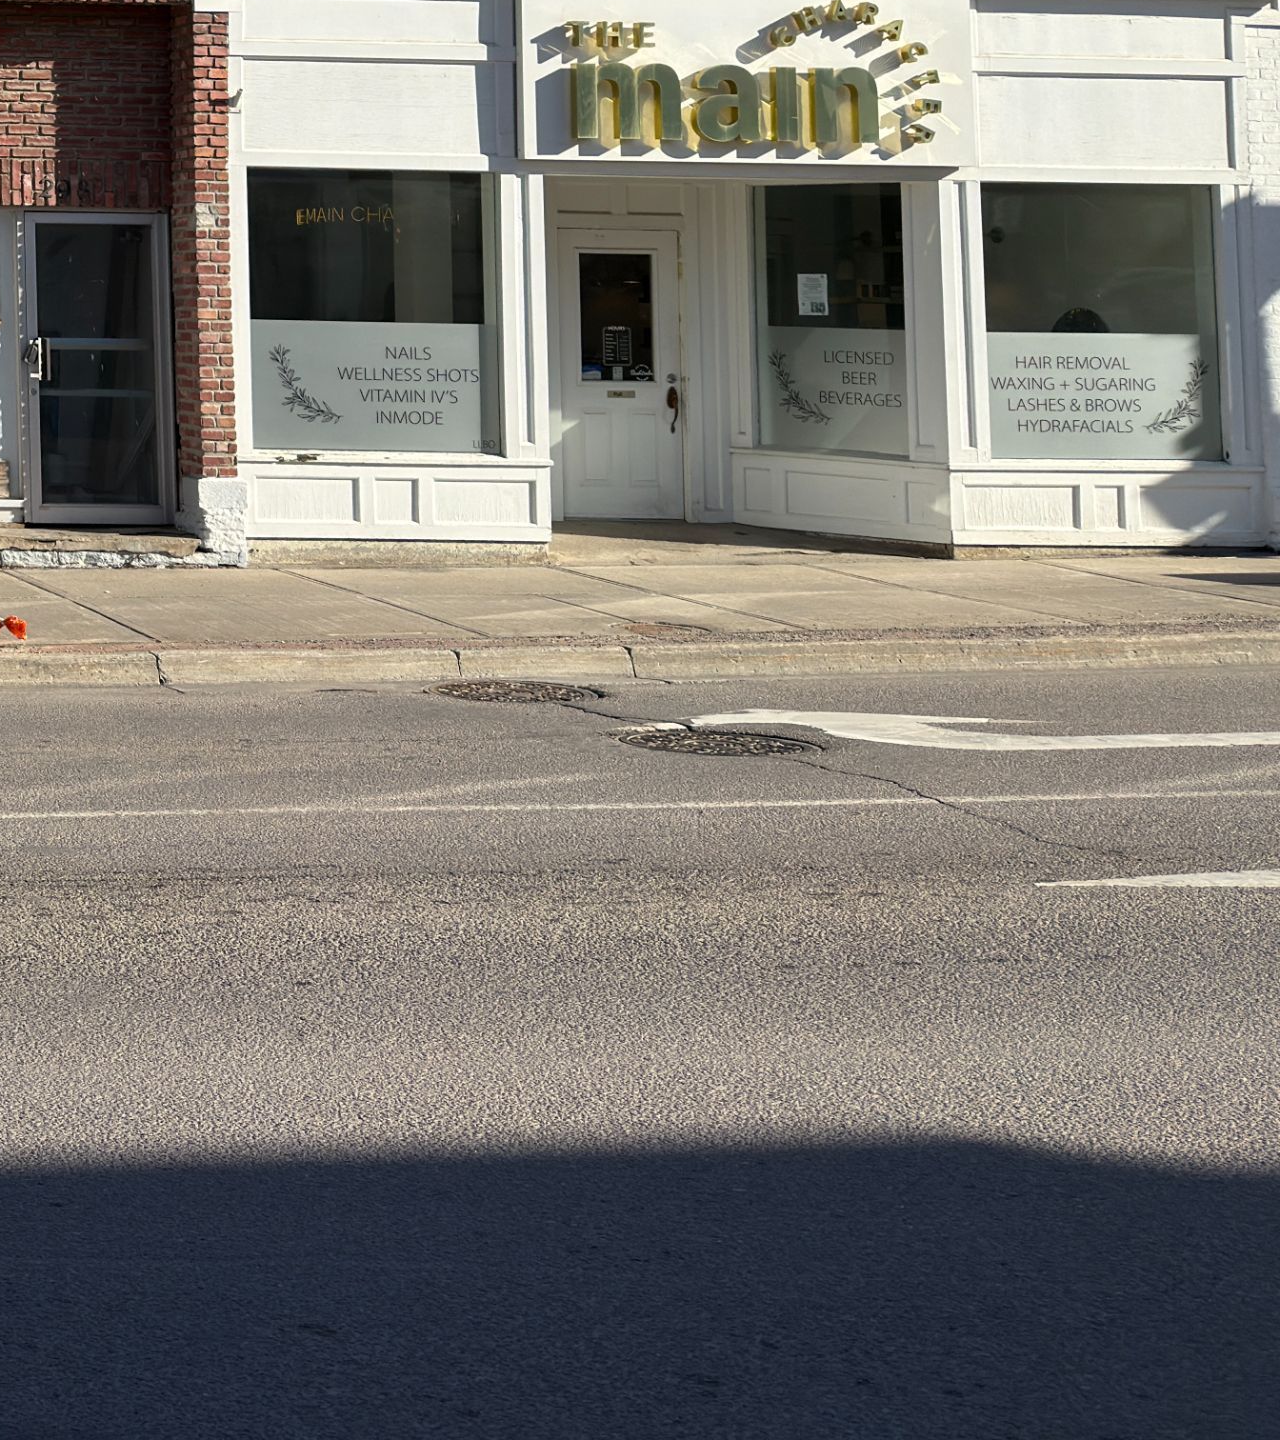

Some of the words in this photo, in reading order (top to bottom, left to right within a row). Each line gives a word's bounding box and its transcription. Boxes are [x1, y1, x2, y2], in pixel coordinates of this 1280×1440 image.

[567, 20, 656, 48] THE
[570, 62, 880, 145] main
[306, 207, 344, 224] MAIN
[385, 346, 432, 360] NAILS
[823, 350, 895, 365] LICENSED
[1015, 355, 1052, 369] HAIR
[1056, 356, 1131, 370] REMOVAL
[337, 367, 422, 381] WELLNESS
[427, 368, 480, 383] SHOTS
[842, 371, 877, 385] BEER
[991, 377, 1055, 391] WAXING
[1075, 378, 1156, 392] SUGARING
[359, 388, 426, 403] VITAMIN
[431, 390, 459, 404] IV'S
[819, 390, 902, 408] BEVERAGES
[1007, 398, 1066, 411] LASHES
[1070, 398, 1081, 412] &
[1085, 399, 1142, 412] BROWS
[376, 411, 444, 425] INMODE
[1018, 419, 1133, 434] HYDRAFACIALS
